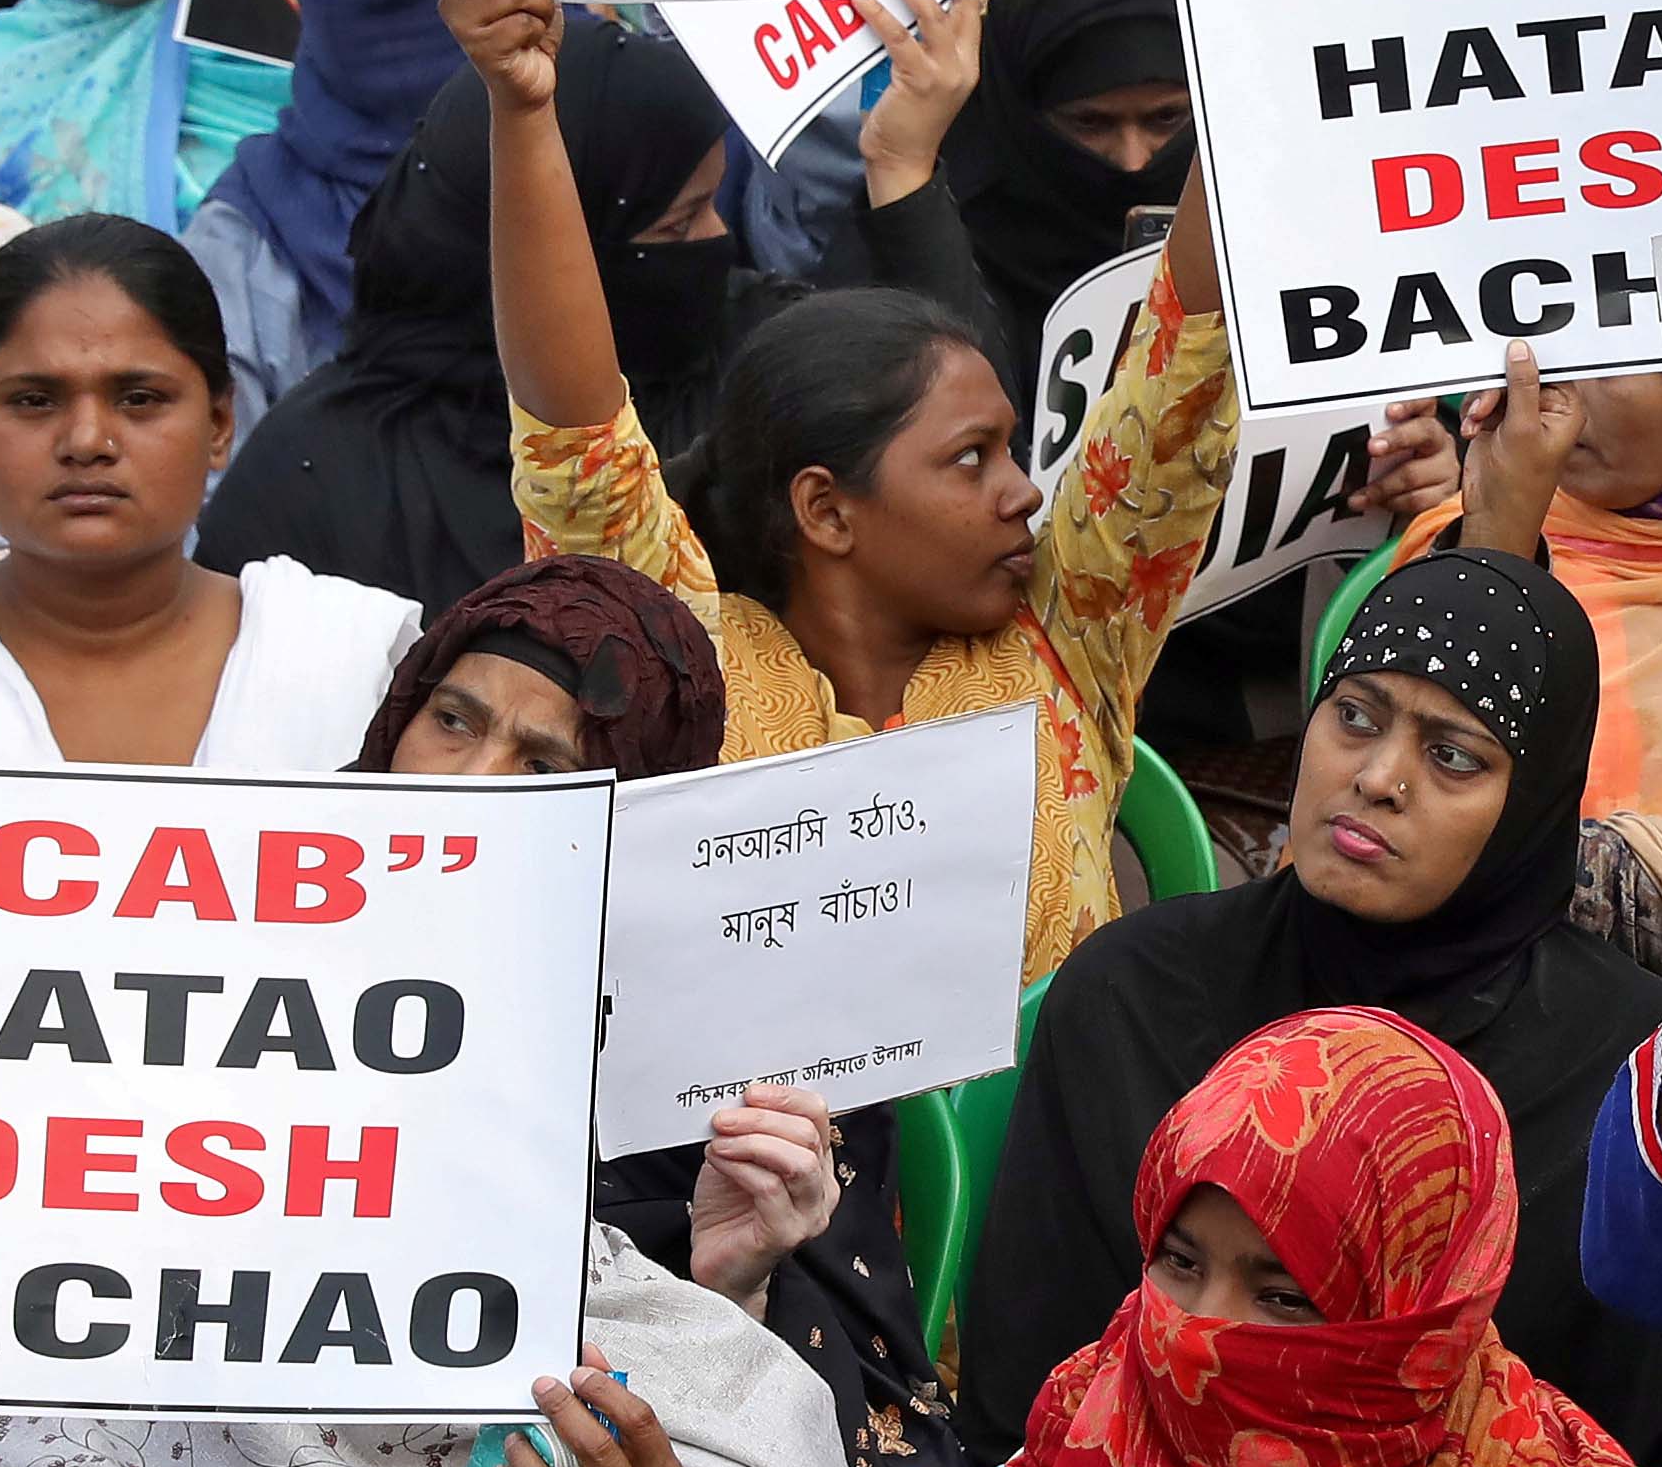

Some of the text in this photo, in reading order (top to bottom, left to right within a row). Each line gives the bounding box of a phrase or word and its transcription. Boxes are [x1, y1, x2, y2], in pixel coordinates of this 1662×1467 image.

[1278, 250, 1662, 366] BACH
[691, 808, 829, 870] এনআরসি
[721, 900, 801, 950] মানুষ
